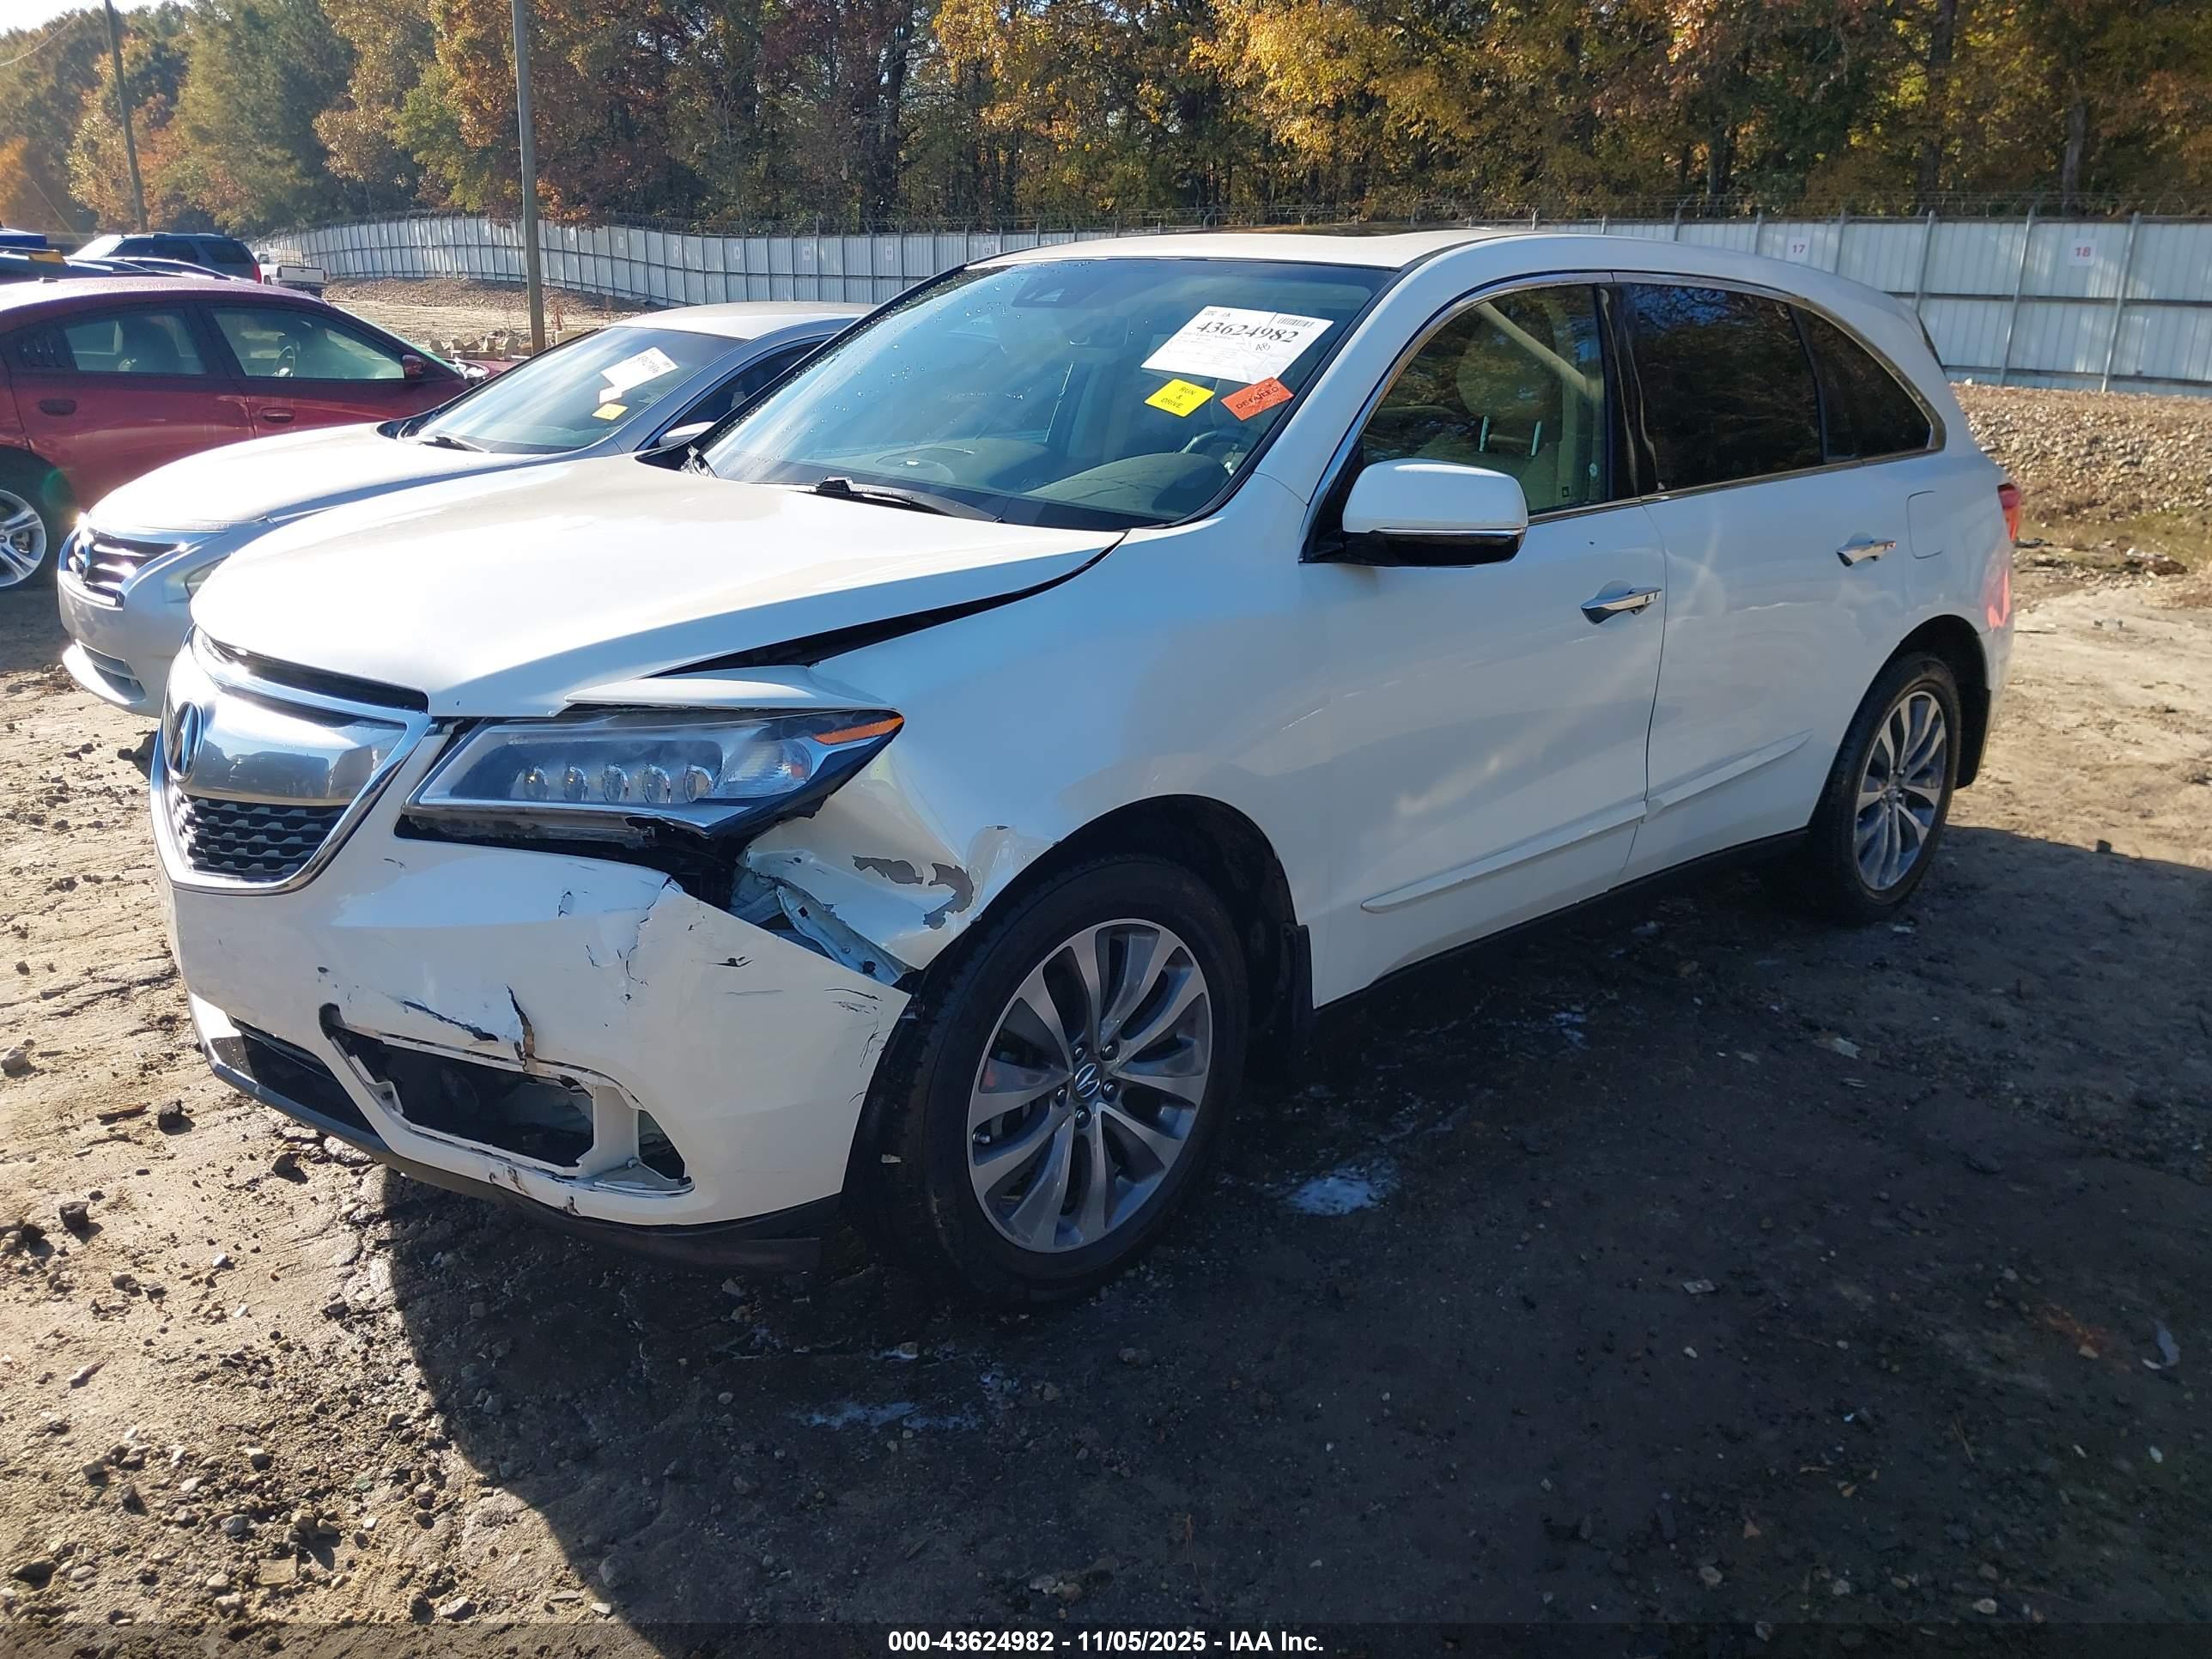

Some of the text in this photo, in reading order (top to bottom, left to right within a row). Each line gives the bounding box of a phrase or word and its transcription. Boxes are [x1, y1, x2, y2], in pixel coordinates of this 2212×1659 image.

[1792, 244, 1806, 253] 17
[2075, 246, 2091, 258] 18
[1196, 321, 1299, 343] 43624982
[1179, 386, 1196, 396] RUN
[1160, 398, 1184, 409] DRIVE
